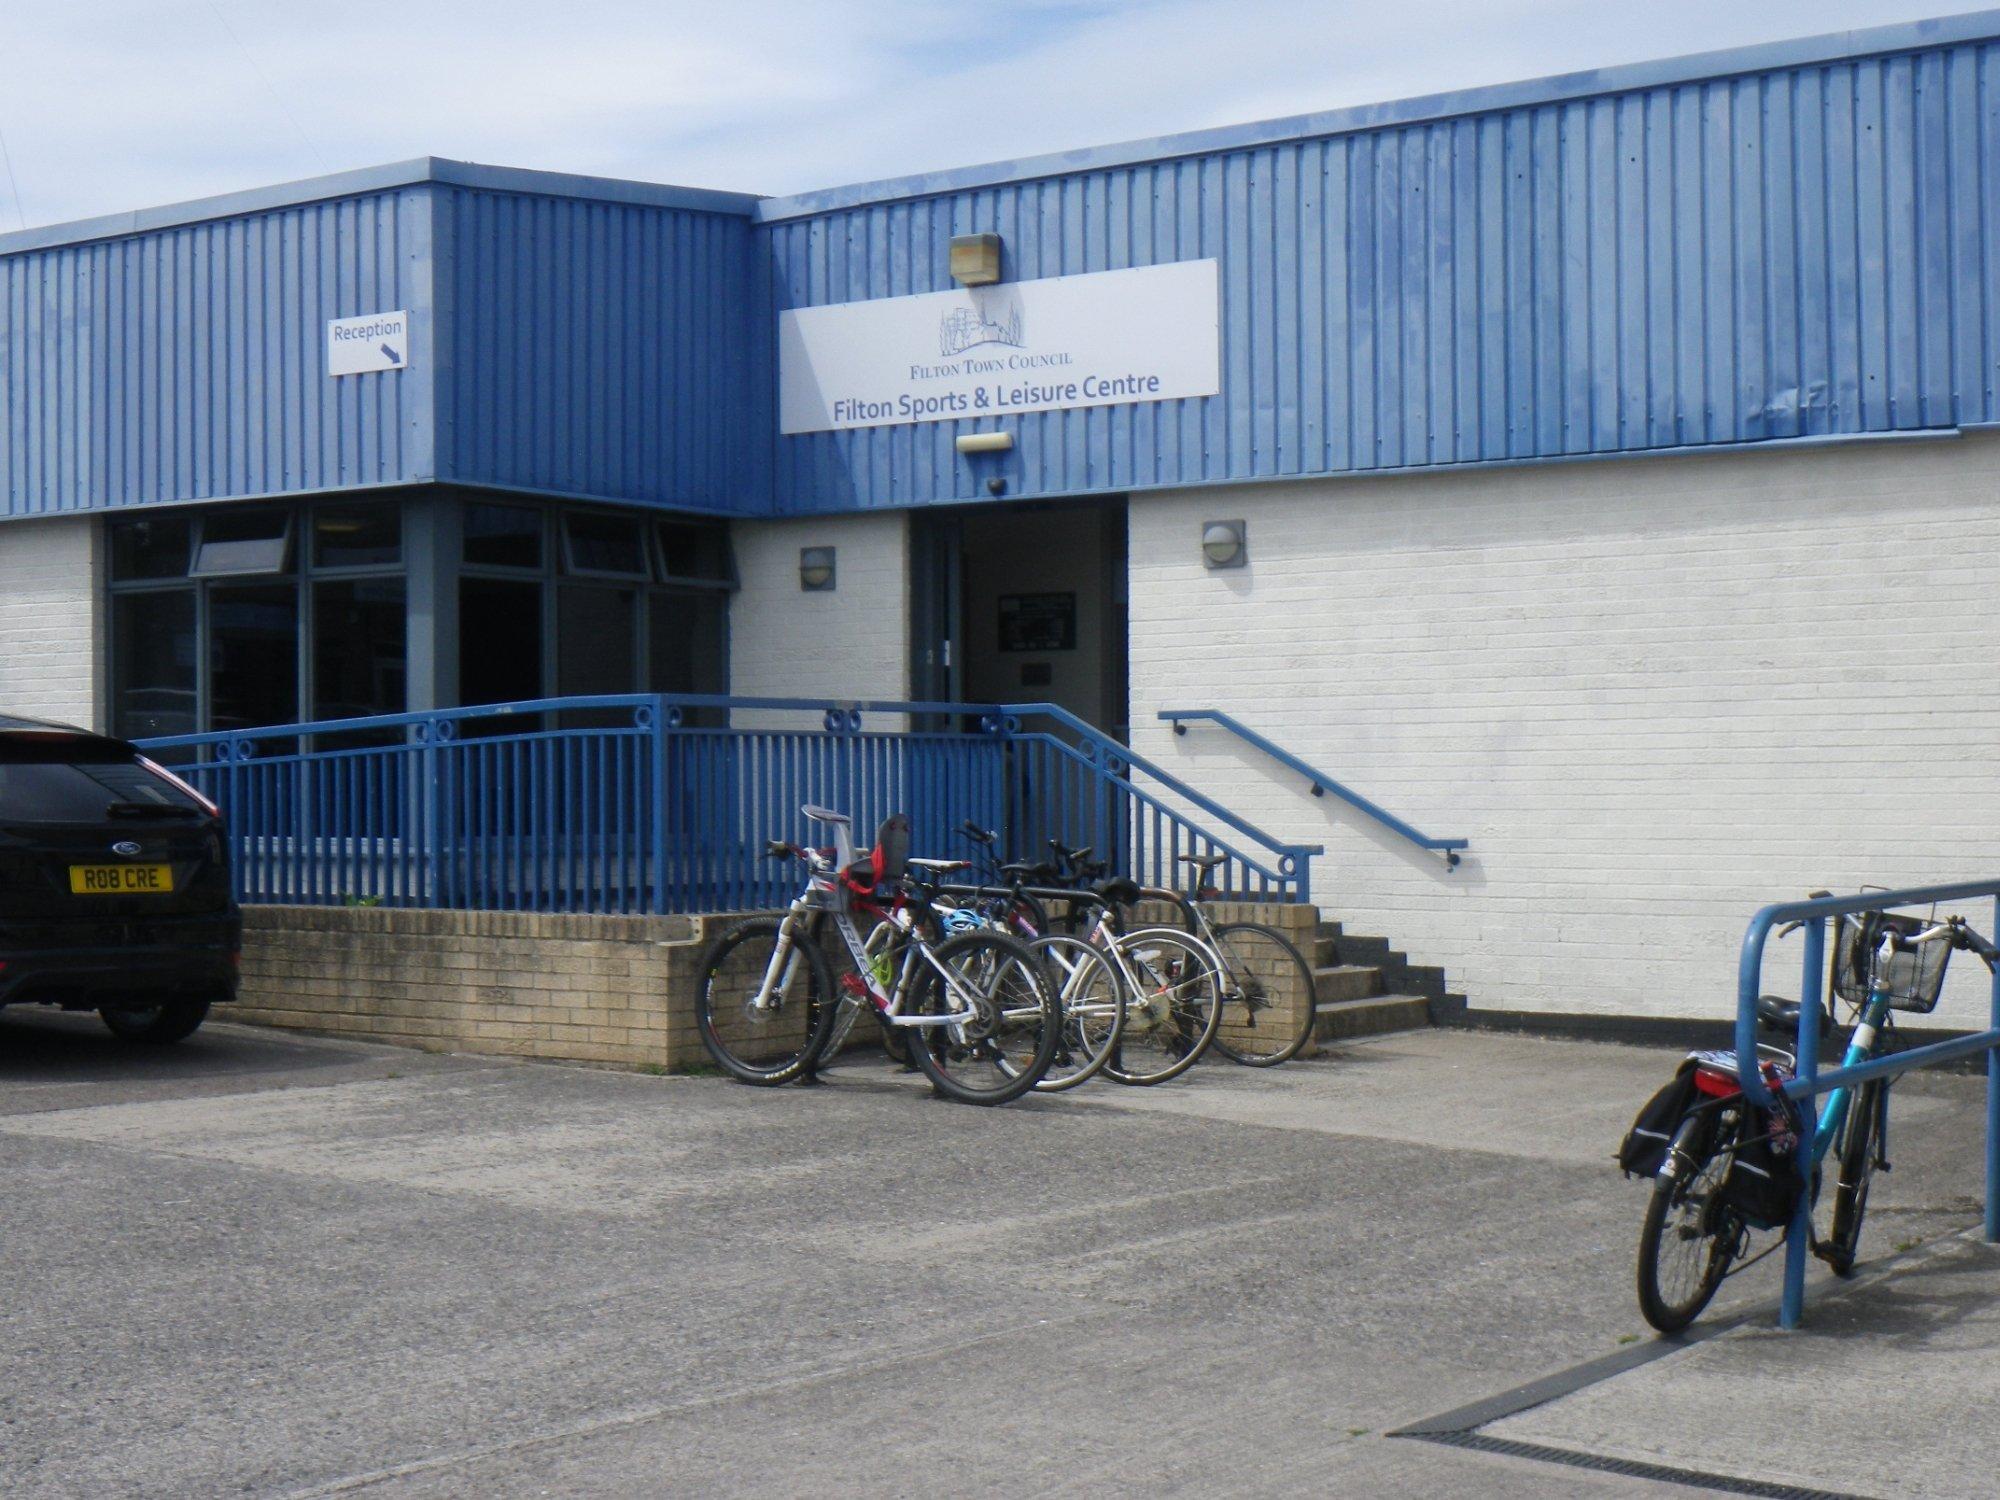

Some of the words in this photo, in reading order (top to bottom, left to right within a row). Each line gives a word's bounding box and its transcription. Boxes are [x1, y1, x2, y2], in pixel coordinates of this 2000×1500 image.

[334, 319, 401, 342] Reception
[963, 358, 1004, 374] TOWN
[1008, 353, 1073, 370] COUNCIL
[834, 398, 893, 422] Filton
[899, 391, 967, 421] Sports
[974, 386, 990, 409] &
[997, 381, 1077, 406] Leisure
[1083, 374, 1160, 398] Centre
[124, 868, 160, 888] CRE
